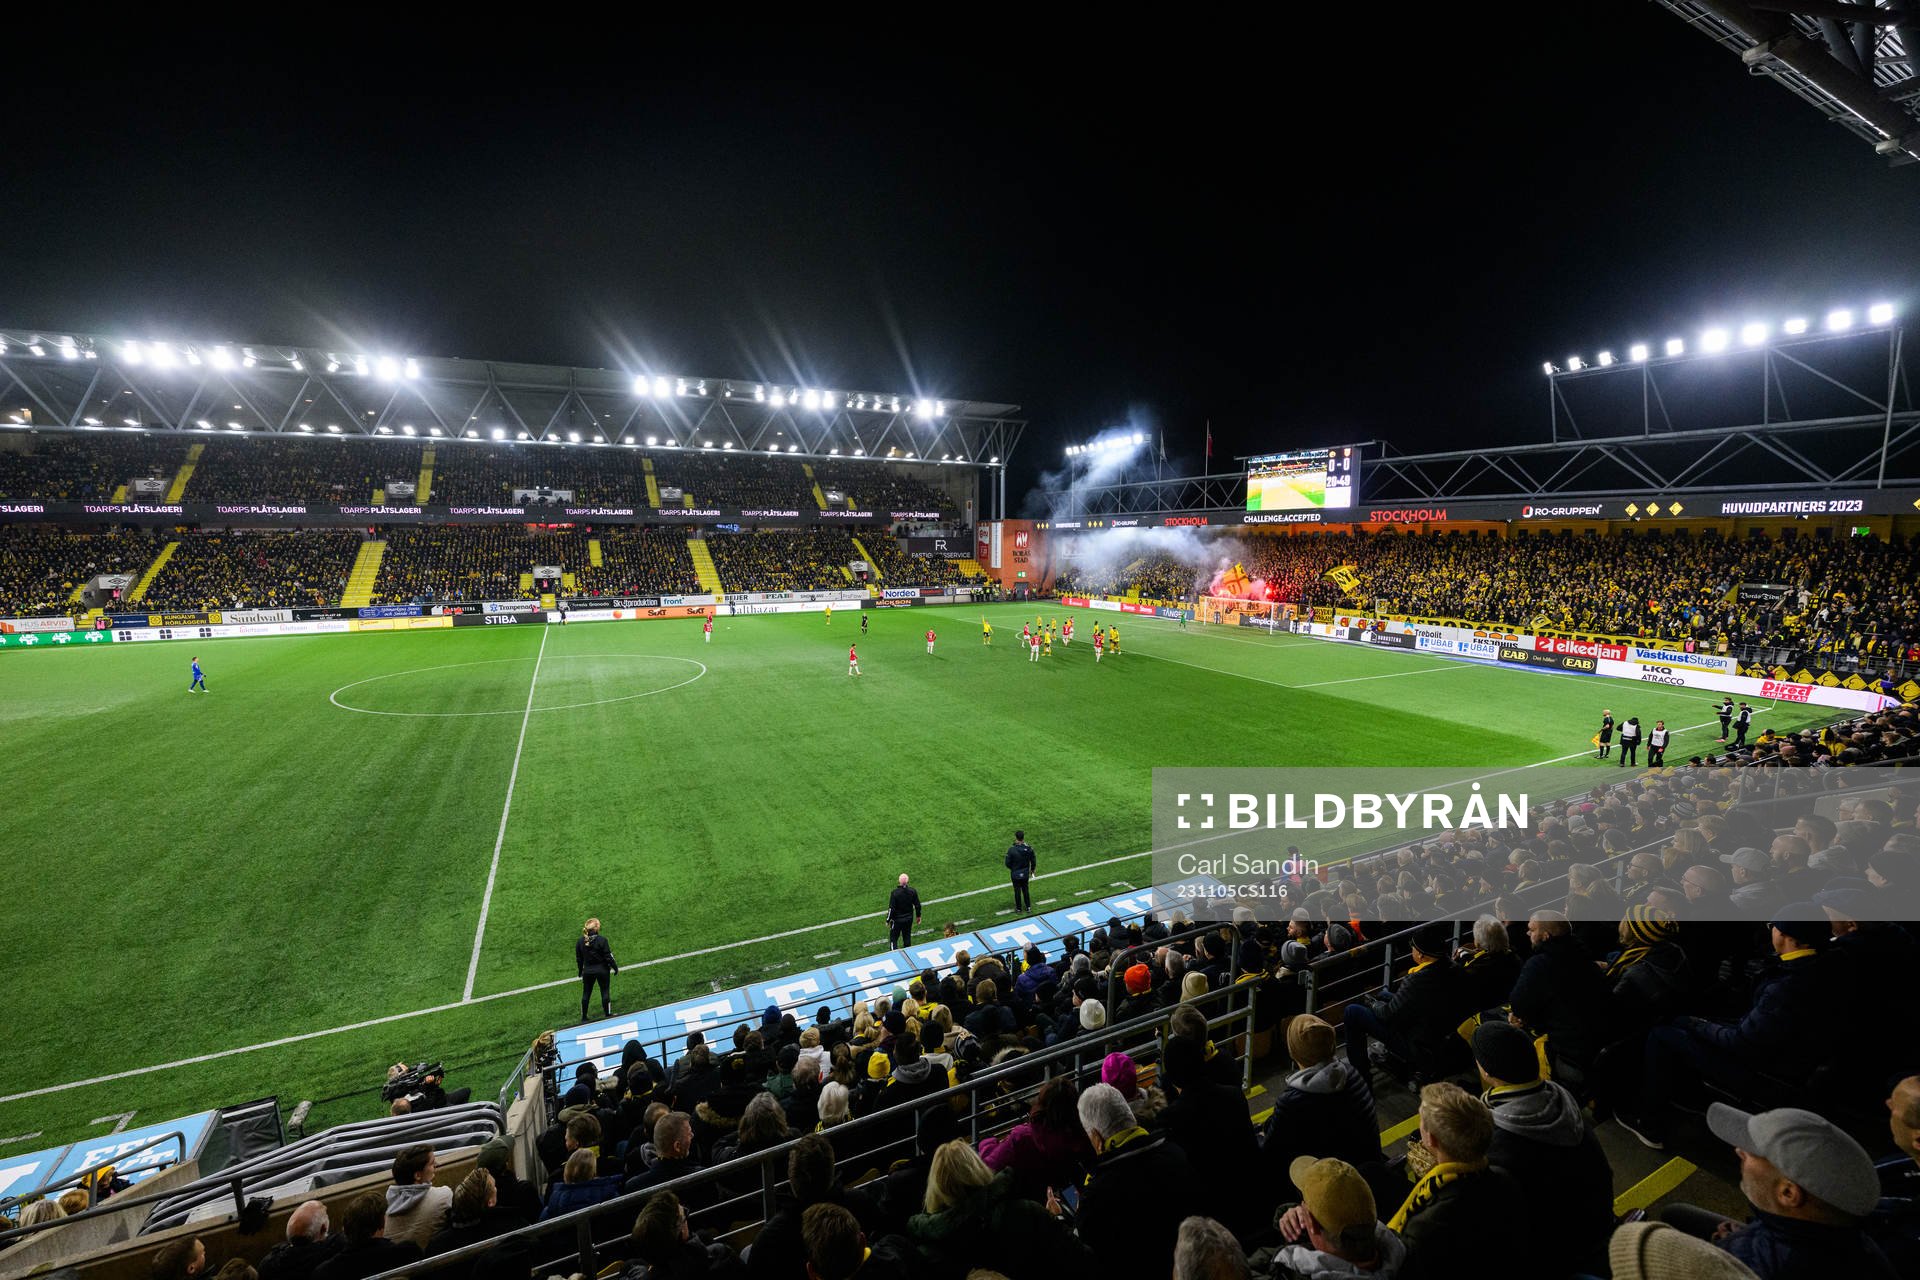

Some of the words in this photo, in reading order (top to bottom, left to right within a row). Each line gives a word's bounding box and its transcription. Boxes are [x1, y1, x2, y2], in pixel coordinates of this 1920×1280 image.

[84, 505, 120, 513] TOARPS
[122, 504, 182, 513] PLÅTSLAGERI
[251, 505, 306, 514] PLÅTSLAGERI
[371, 505, 421, 514] PLÅTSLAGERI
[478, 507, 524, 515] PLÅTSLAGERI
[591, 507, 633, 516] PLÅTSLAGERI
[1534, 504, 1600, 516] RO-GRUPPEN
[1722, 501, 1827, 514] HUVUDPARTNERS
[1828, 499, 1863, 512] 2023
[1370, 508, 1447, 522] STOCKHOLM
[1164, 517, 1208, 527] STOCKHOLM
[935, 540, 948, 551] FR
[911, 551, 971, 559] FASTIGSSERVICE
[885, 590, 916, 598] Nordea
[663, 597, 683, 605] front
[229, 611, 285, 623] Sandwall
[485, 614, 518, 625] STIBA
[1415, 629, 1442, 639] Trebolit
[1430, 638, 1453, 648] UBAB
[1470, 642, 1495, 653] UBAB
[1556, 639, 1621, 659] elkedjan
[1503, 650, 1526, 661] EAB
[1565, 658, 1592, 669] EAB
[1636, 648, 1727, 668] VästkustStugan
[1642, 664, 1672, 676] LKQ
[1641, 674, 1685, 686] ATRACCO
[1761, 681, 1814, 697] Direct
